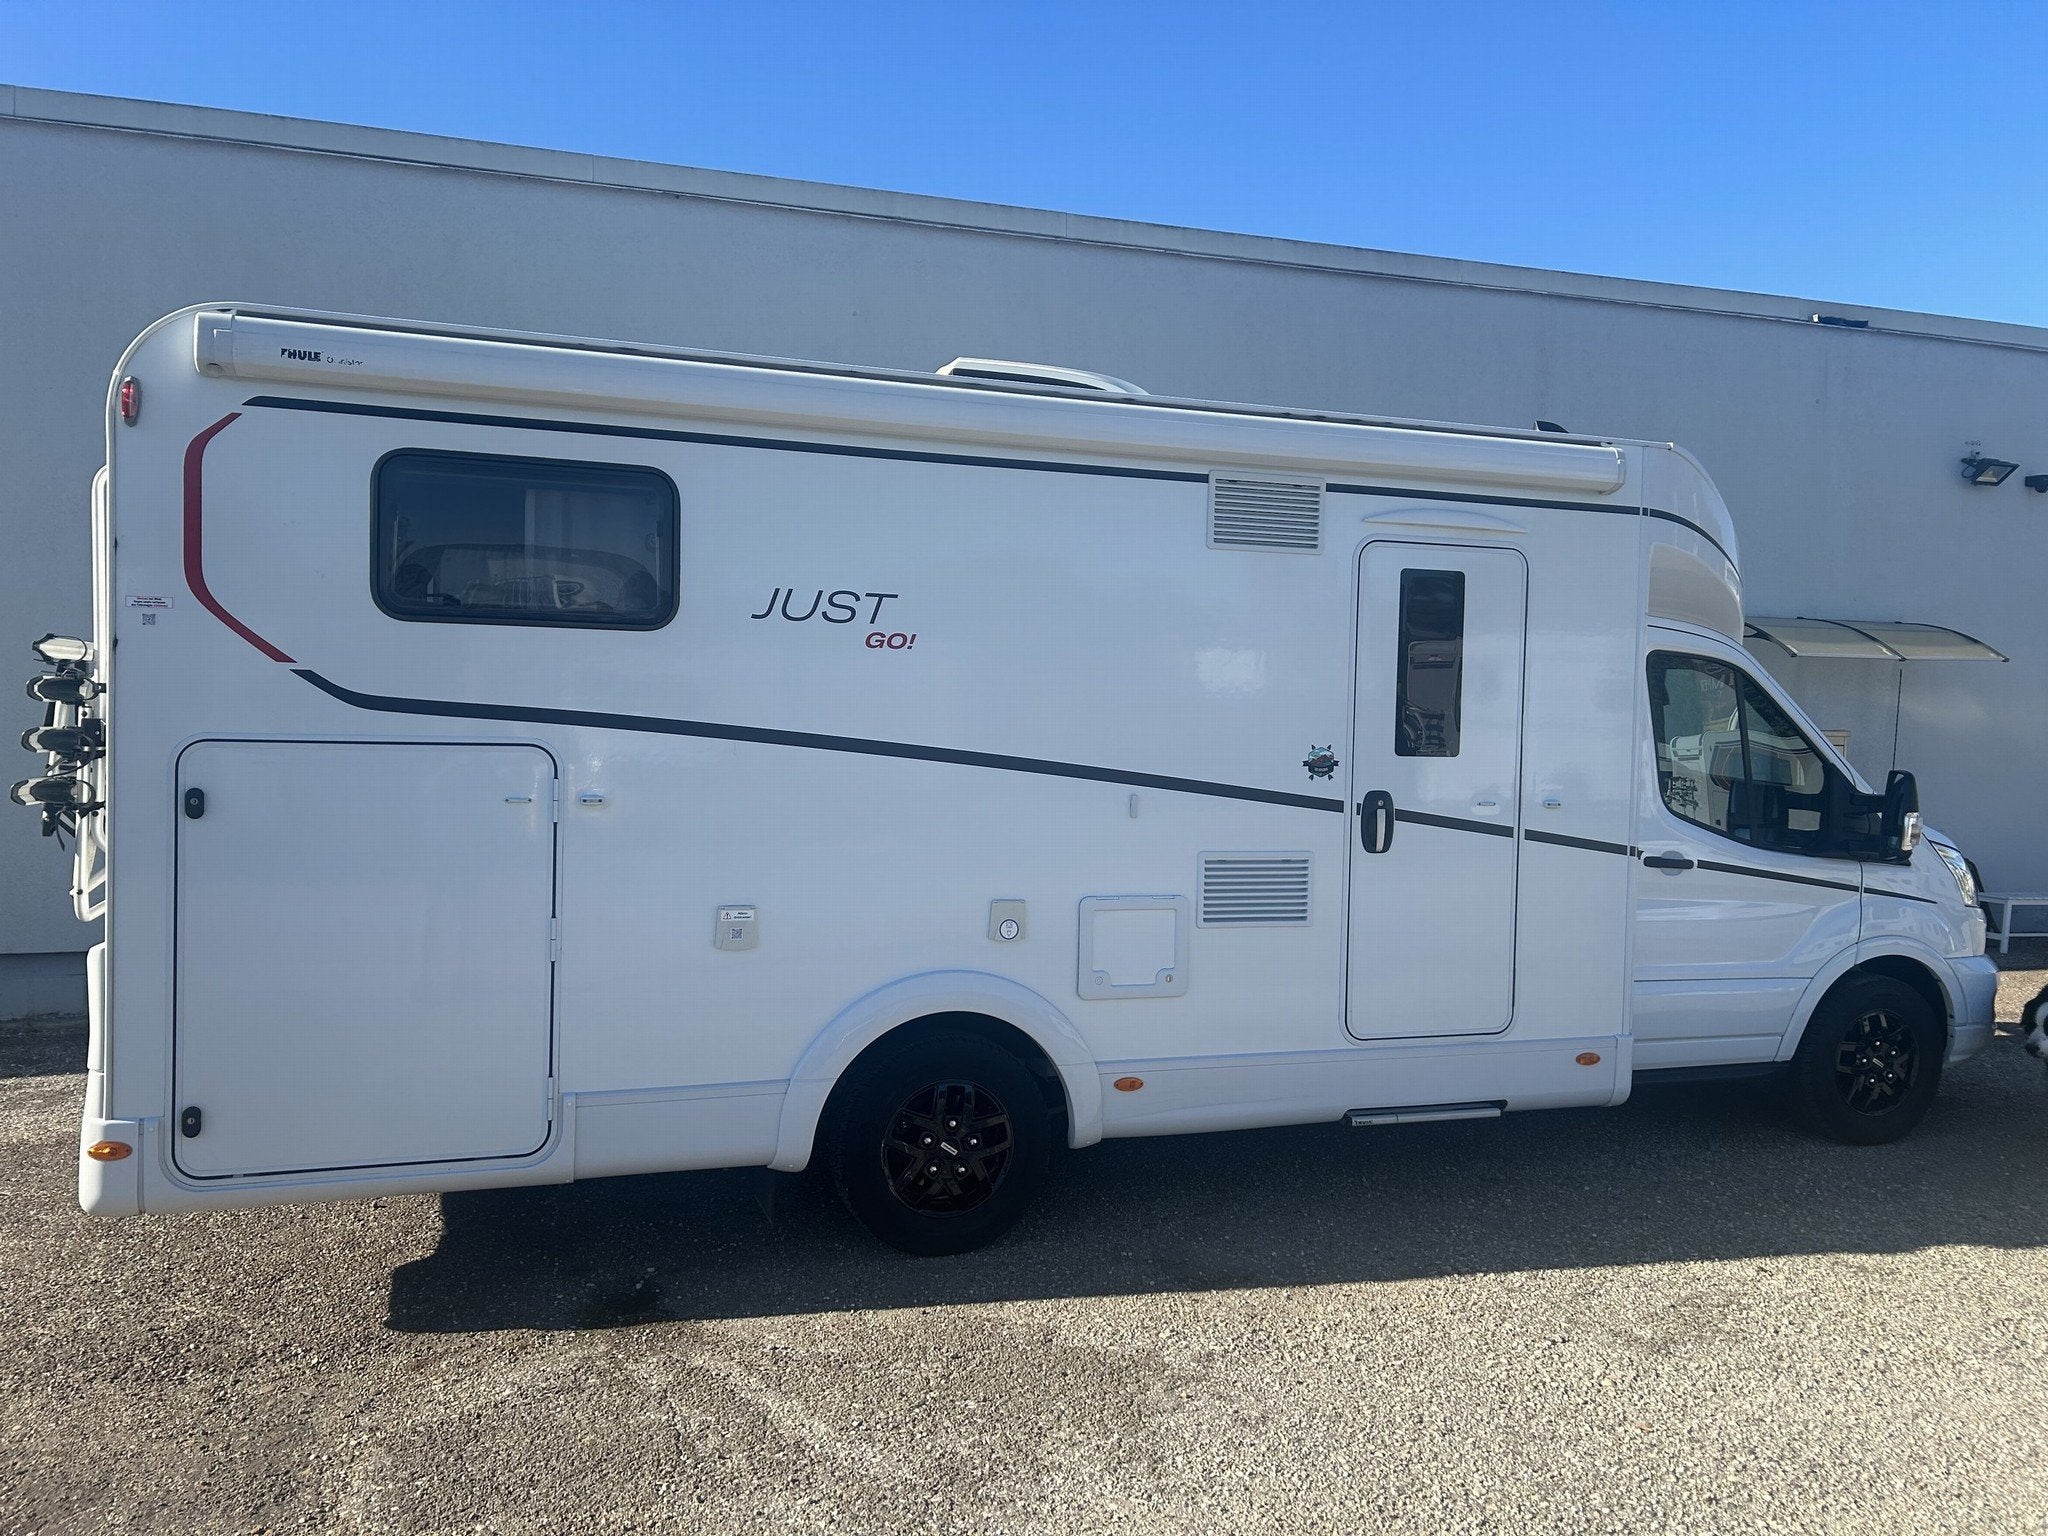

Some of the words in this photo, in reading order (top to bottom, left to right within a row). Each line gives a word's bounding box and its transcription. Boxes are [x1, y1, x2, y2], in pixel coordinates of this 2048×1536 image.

[281, 348, 321, 362] THULE
[750, 587, 899, 625] JUST
[865, 631, 917, 650] GO!
